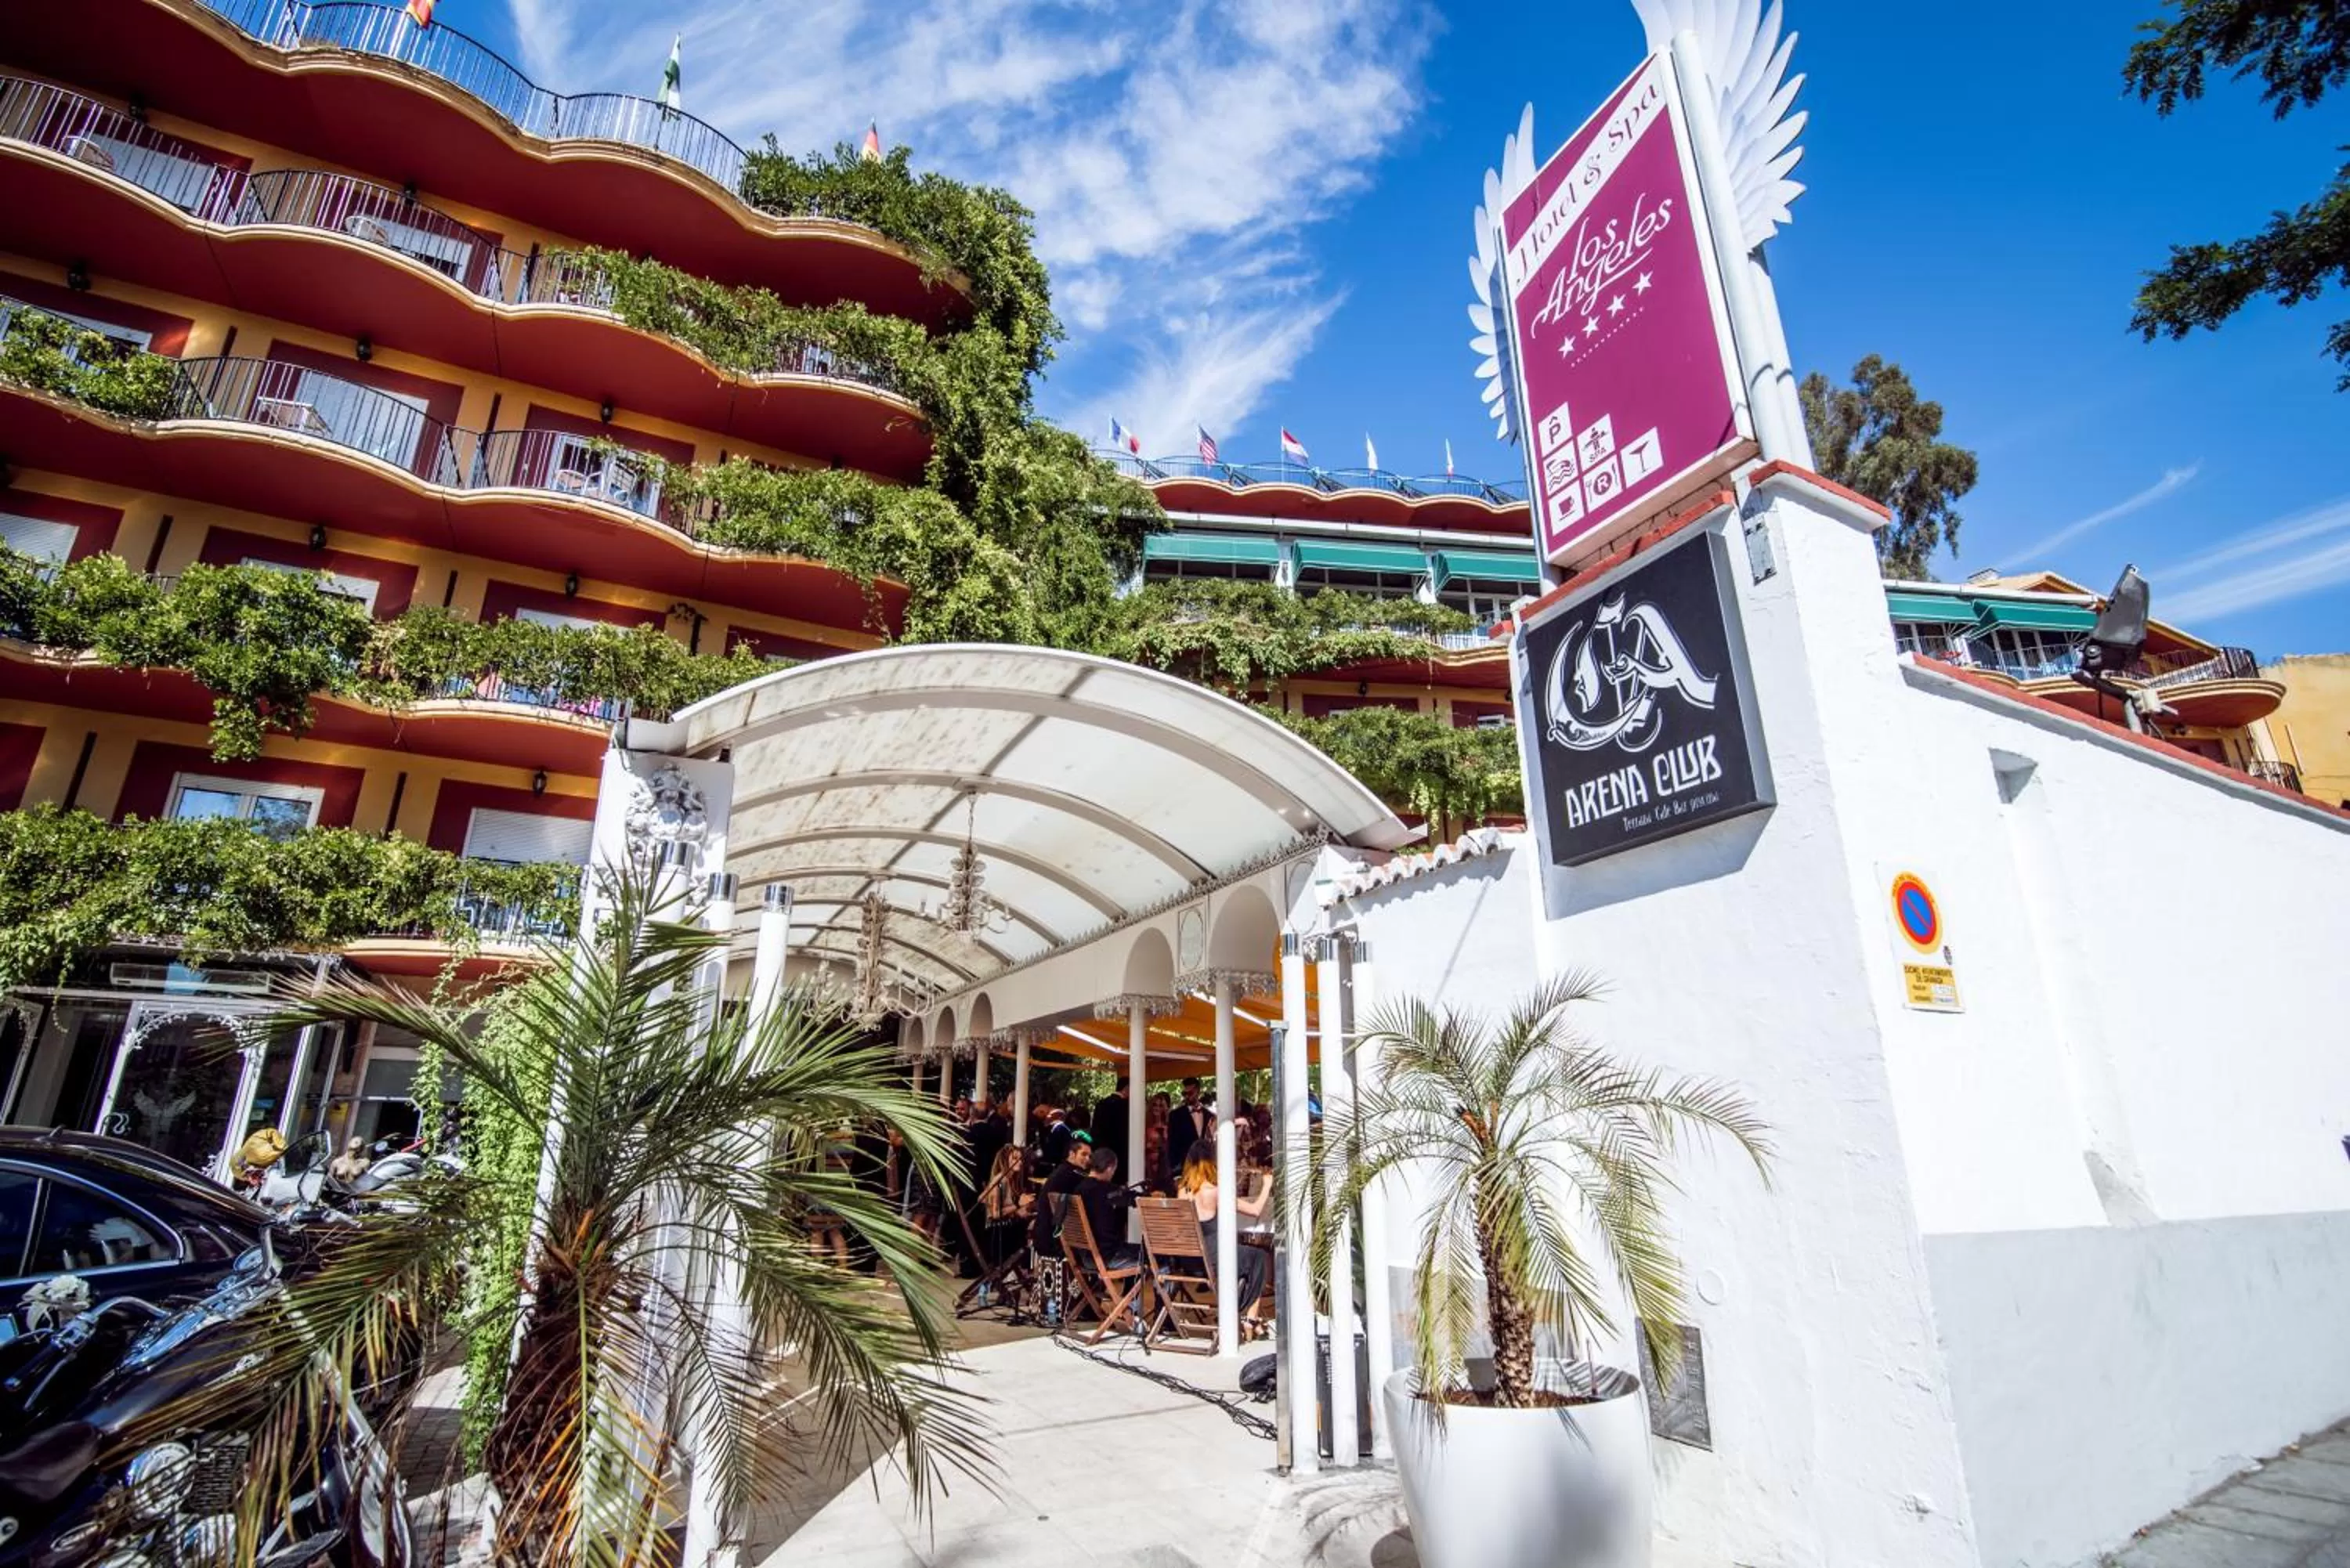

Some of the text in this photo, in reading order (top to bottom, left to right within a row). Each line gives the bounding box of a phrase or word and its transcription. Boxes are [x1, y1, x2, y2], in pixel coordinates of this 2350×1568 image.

[1517, 182, 1577, 287] Hotel
[1608, 84, 1659, 153] Spa
[1531, 193, 1672, 339] Angeles
[1564, 734, 1723, 829] ARENA CLUB
